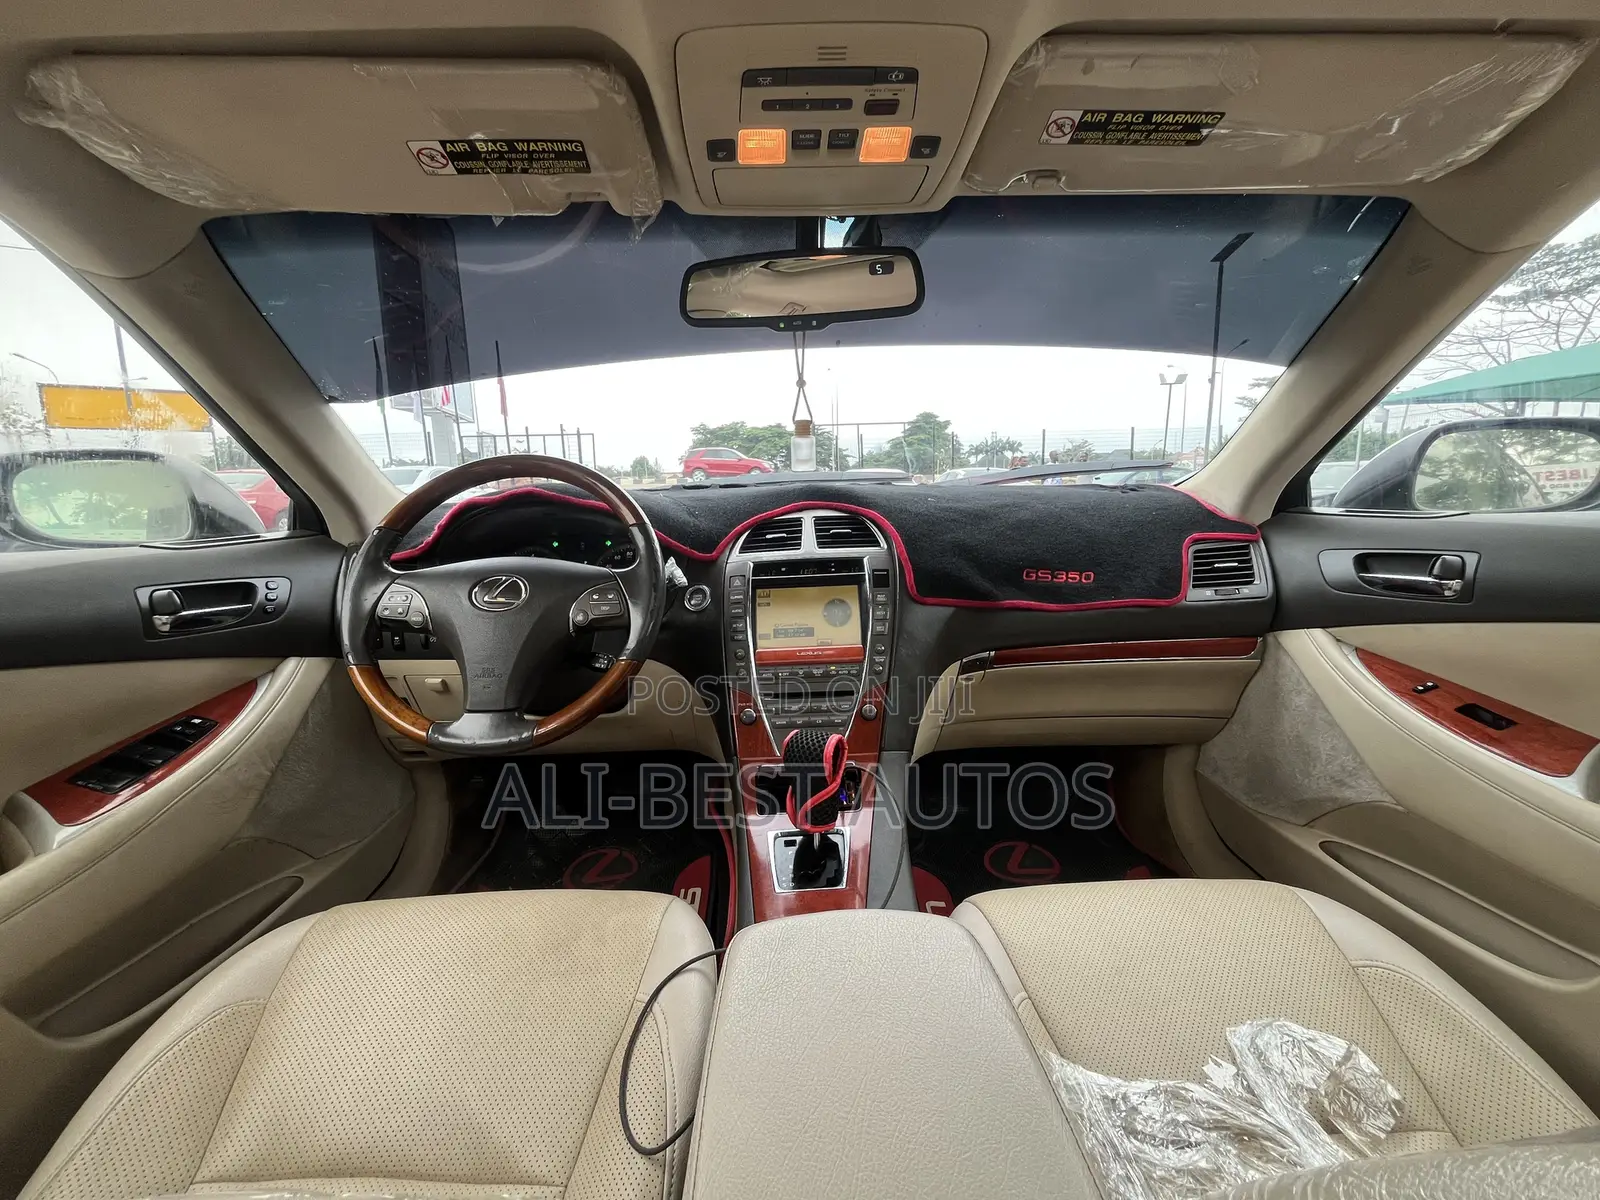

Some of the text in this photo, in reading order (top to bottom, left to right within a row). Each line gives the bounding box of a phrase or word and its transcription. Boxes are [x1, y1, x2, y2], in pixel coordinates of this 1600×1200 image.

[1082, 113, 1221, 124] AIR BAG WARNING
[1073, 131, 1205, 141] COUSSIN GONFLABLE AVERTISSEMENT
[446, 142, 583, 153] AIR BAG WARNING
[453, 160, 587, 169] COUSSIN GONFLABLE AVERTISSEMENT
[1022, 568, 1095, 583] GS350
